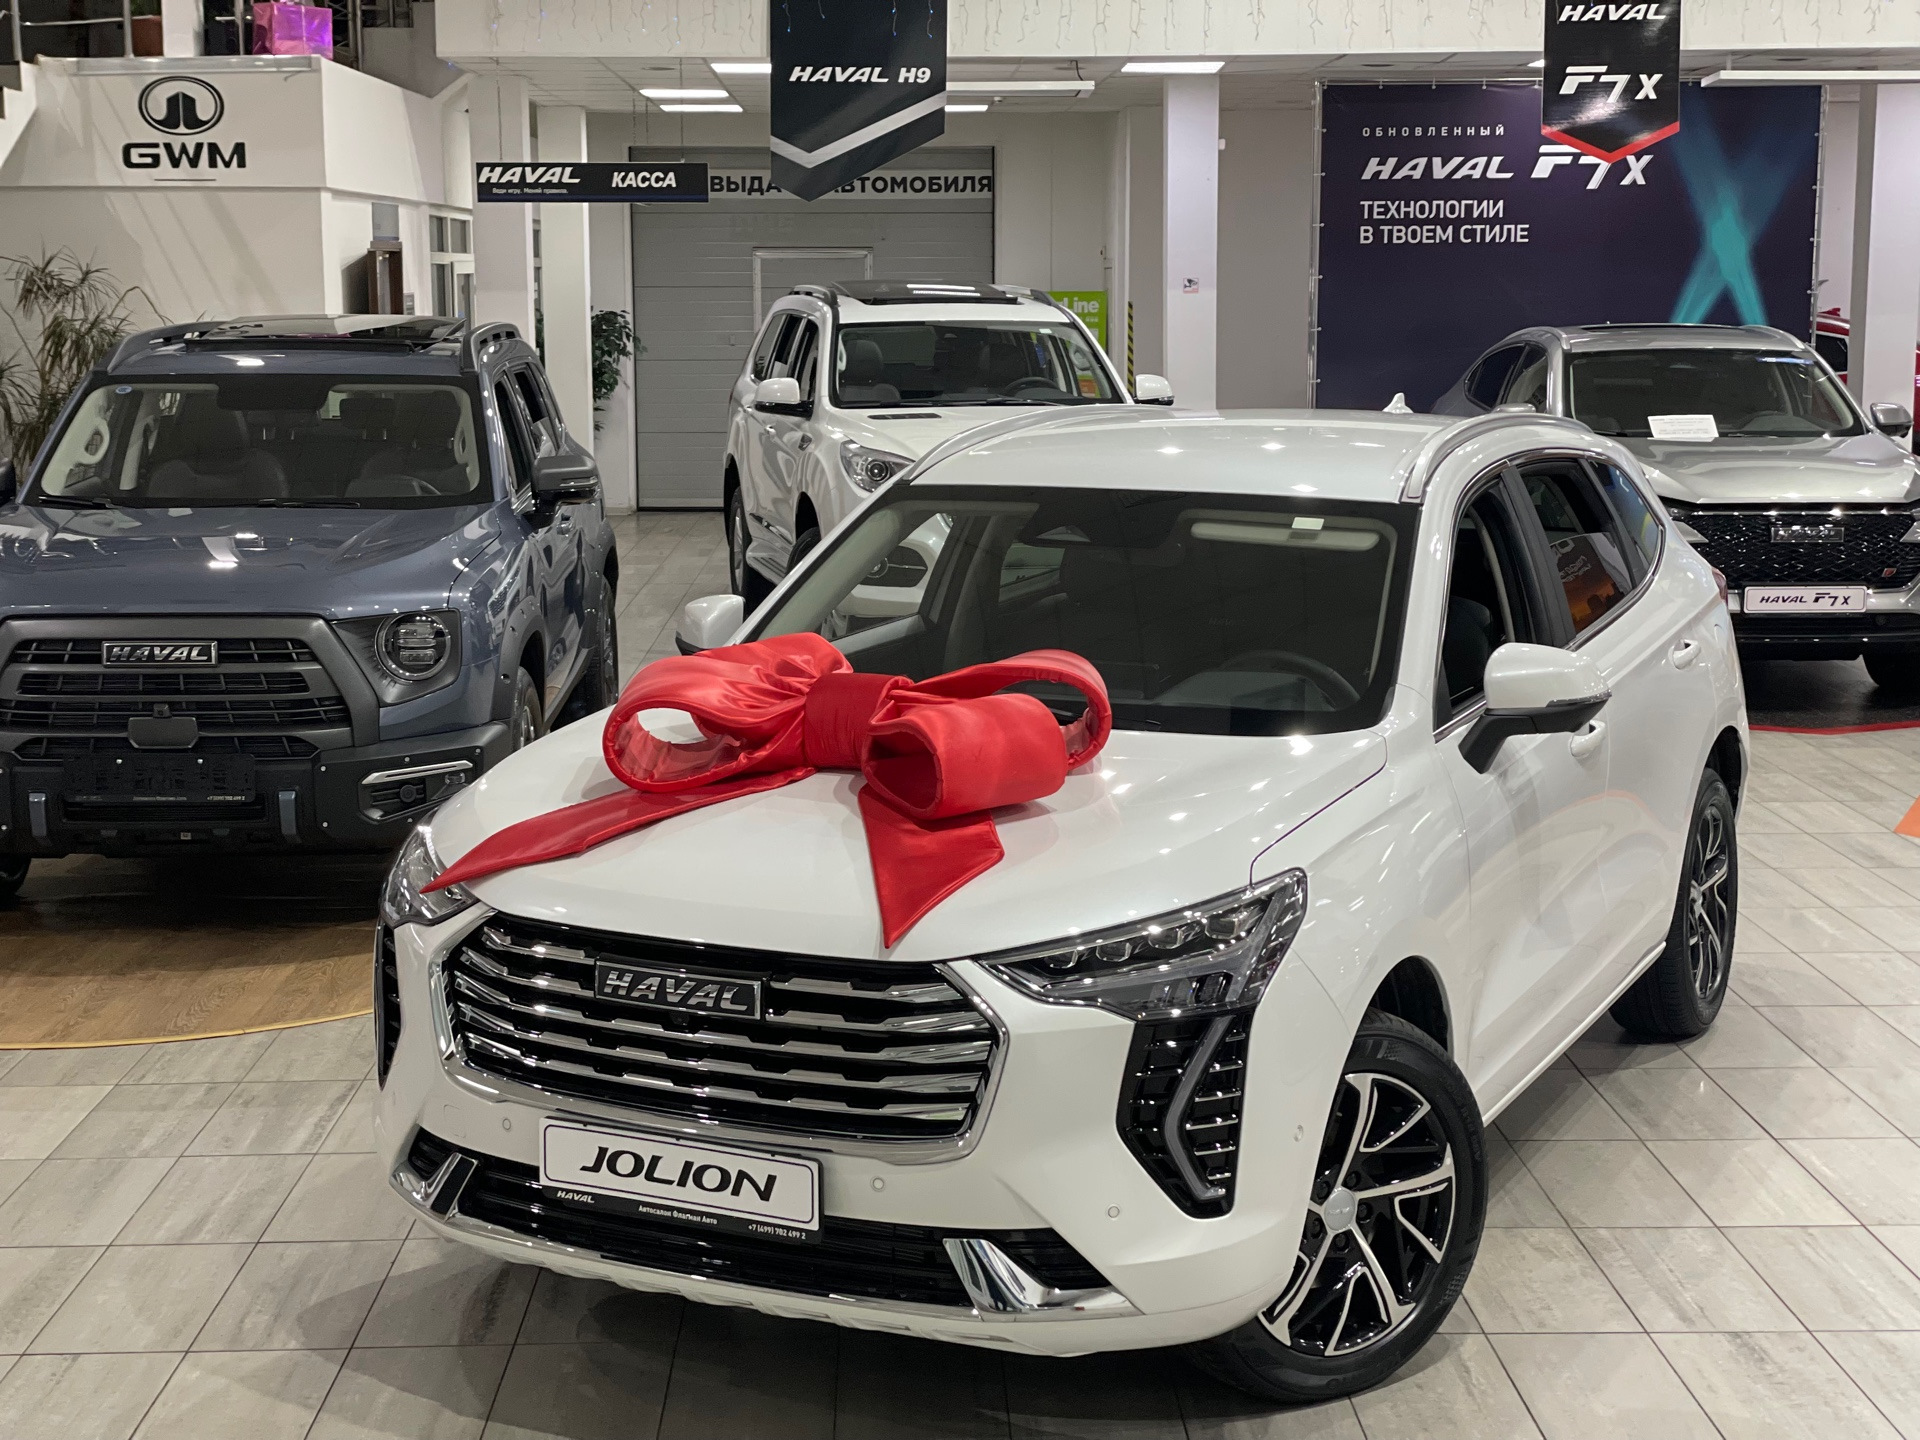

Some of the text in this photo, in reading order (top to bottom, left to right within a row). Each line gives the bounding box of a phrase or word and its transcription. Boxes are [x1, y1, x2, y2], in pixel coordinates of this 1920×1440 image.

[1558, 4, 1667, 22] HAVAL
[789, 66, 931, 84] HAVAL H9
[1362, 124, 1505, 137] ОБНОВЛЕННЫЙ
[122, 142, 246, 169] GWM
[478, 166, 581, 183] HAVAL
[1361, 156, 1515, 180] HAVAL
[611, 171, 677, 188] КАССА
[709, 175, 993, 195] ВЫДА ВТОМОБИЛЯ
[1360, 200, 1504, 219] ТЕХНОЛОГИИ
[1359, 224, 1530, 244] В ТВОЕМ СТИЛЕ
[1057, 297, 1100, 313] Line
[1759, 595, 1808, 604] HAVAL
[109, 646, 208, 661] HAVAL
[603, 970, 748, 1011] HAVAL
[579, 1145, 777, 1202] JOLION
[556, 1190, 595, 1204] HAVAL
[638, 1204, 672, 1217] Автосалон
[701, 1215, 718, 1225] Авто
